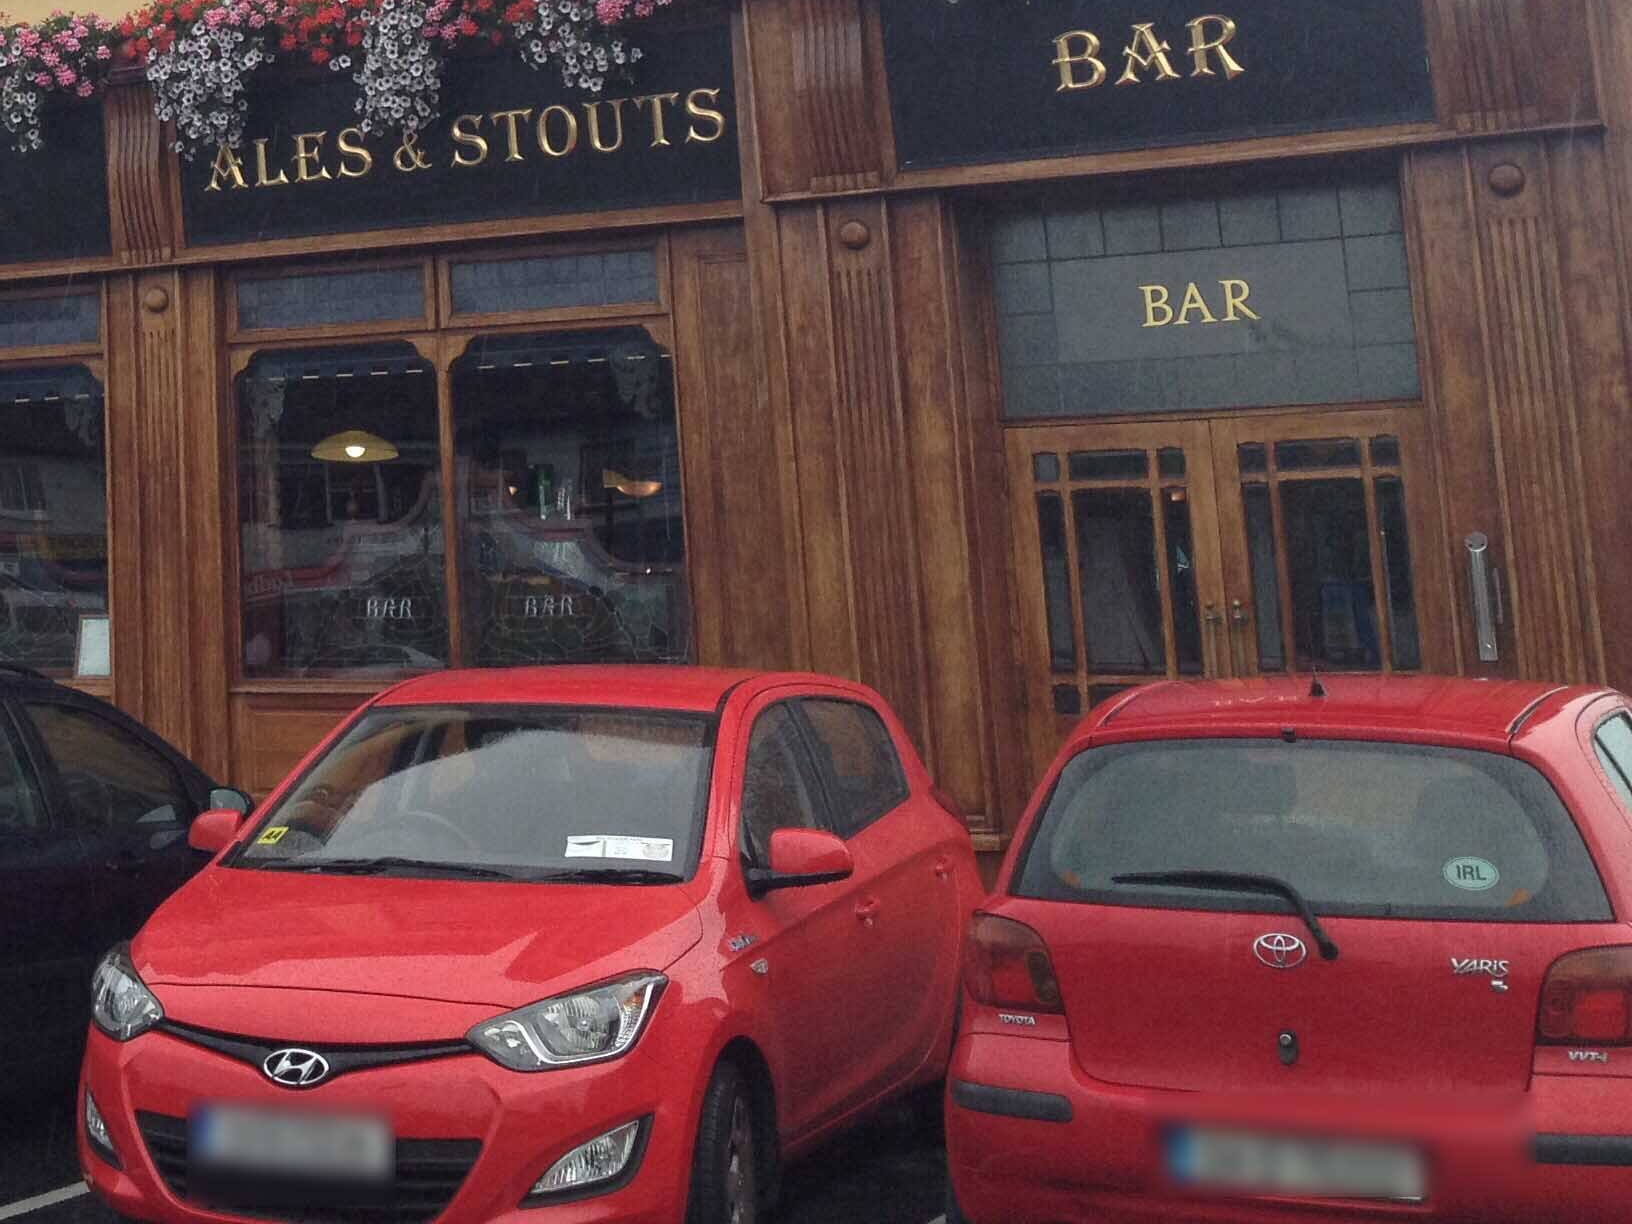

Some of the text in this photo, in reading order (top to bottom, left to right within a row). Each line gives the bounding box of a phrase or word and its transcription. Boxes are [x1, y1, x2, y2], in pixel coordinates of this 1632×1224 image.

[1052, 14, 1246, 92] BAR
[204, 87, 726, 192] ALES & STOUTS
[1137, 279, 1261, 328] BAR
[1455, 864, 1488, 881] IRL
[998, 1013, 1036, 1025] TOYOTA
